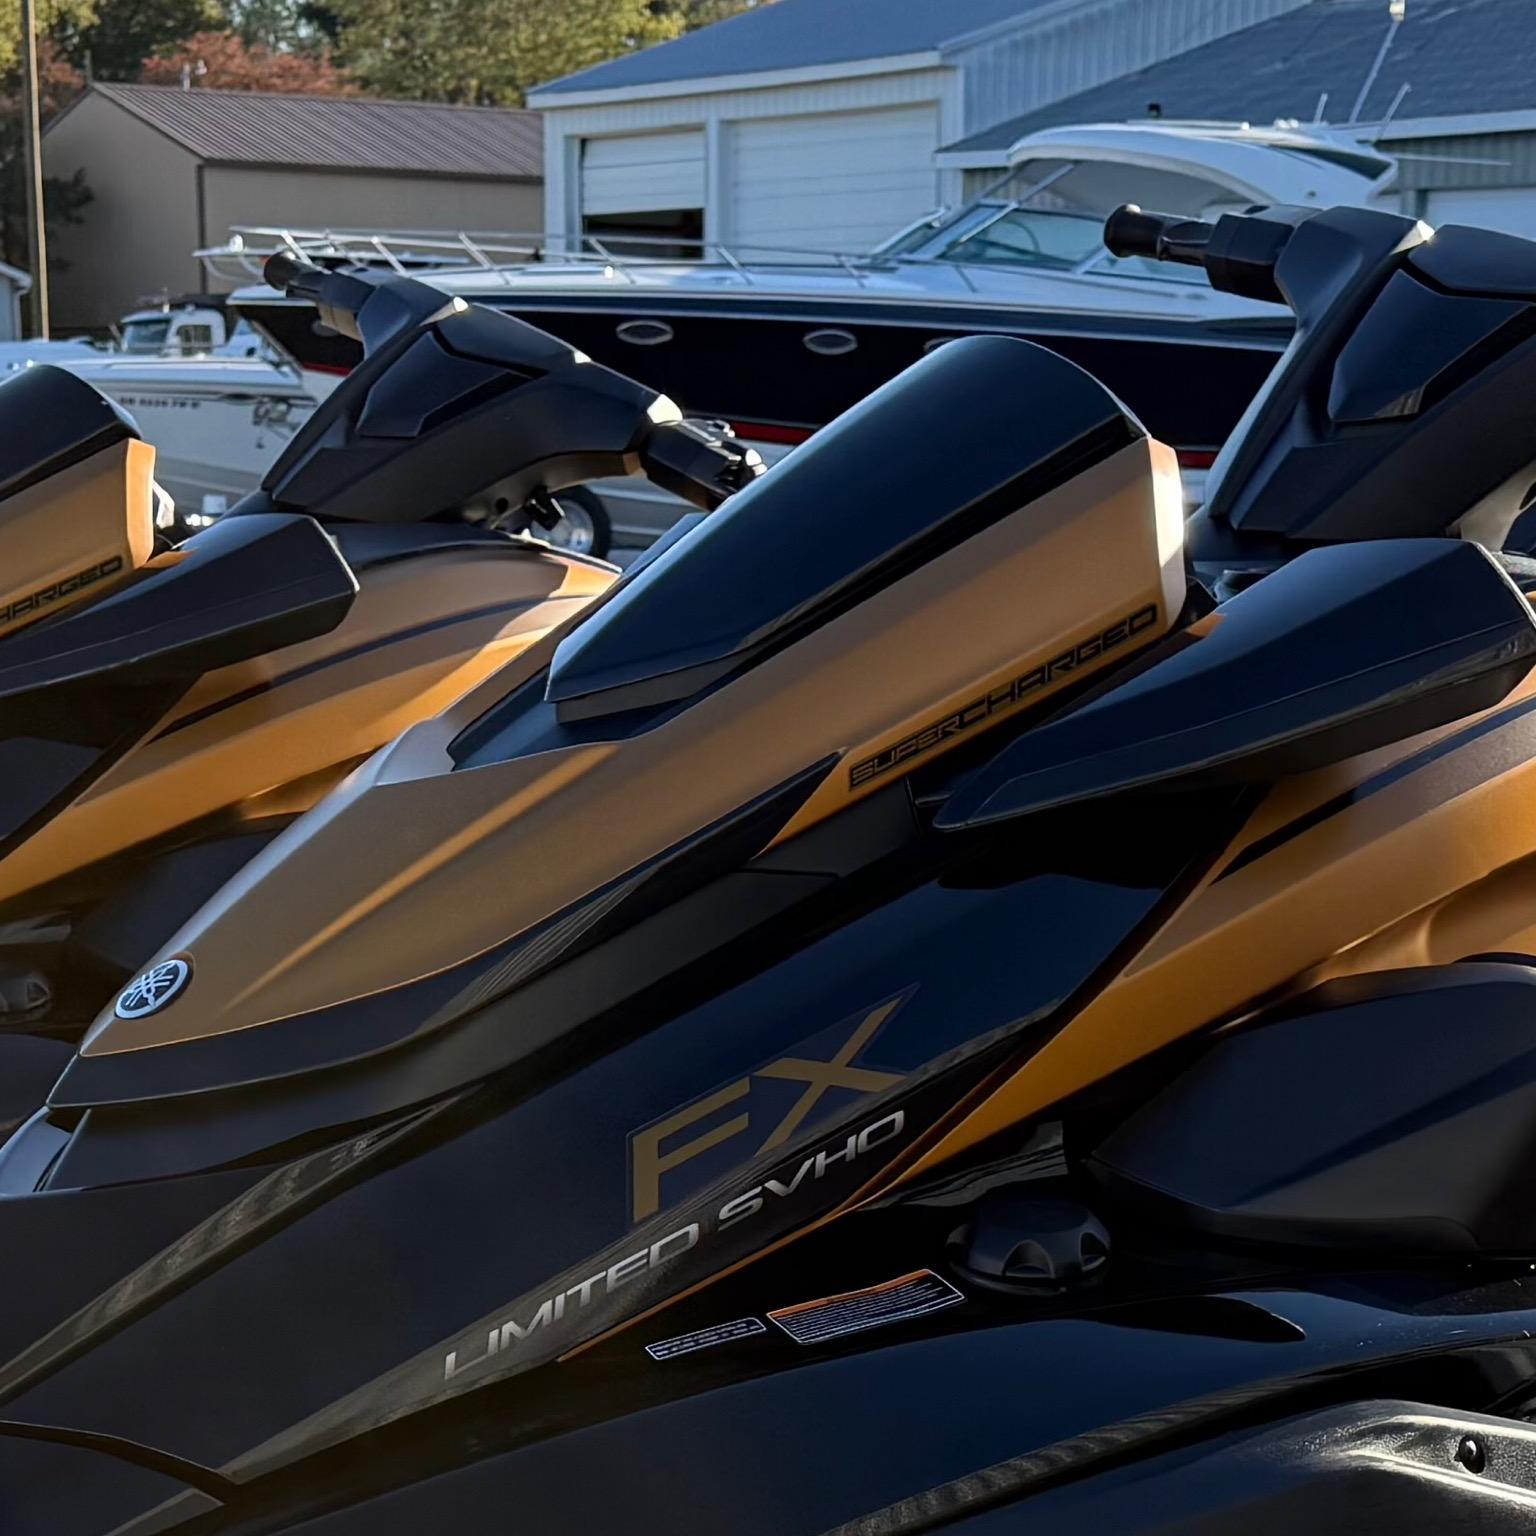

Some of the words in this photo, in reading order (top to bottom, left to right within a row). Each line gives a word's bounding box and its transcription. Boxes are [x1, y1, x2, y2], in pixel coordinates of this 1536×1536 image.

[849, 603, 1157, 792] SUPERCHARGED
[632, 998, 909, 1224] FX
[444, 1222, 700, 1380] LIMITED
[718, 1109, 905, 1231] SVHO
